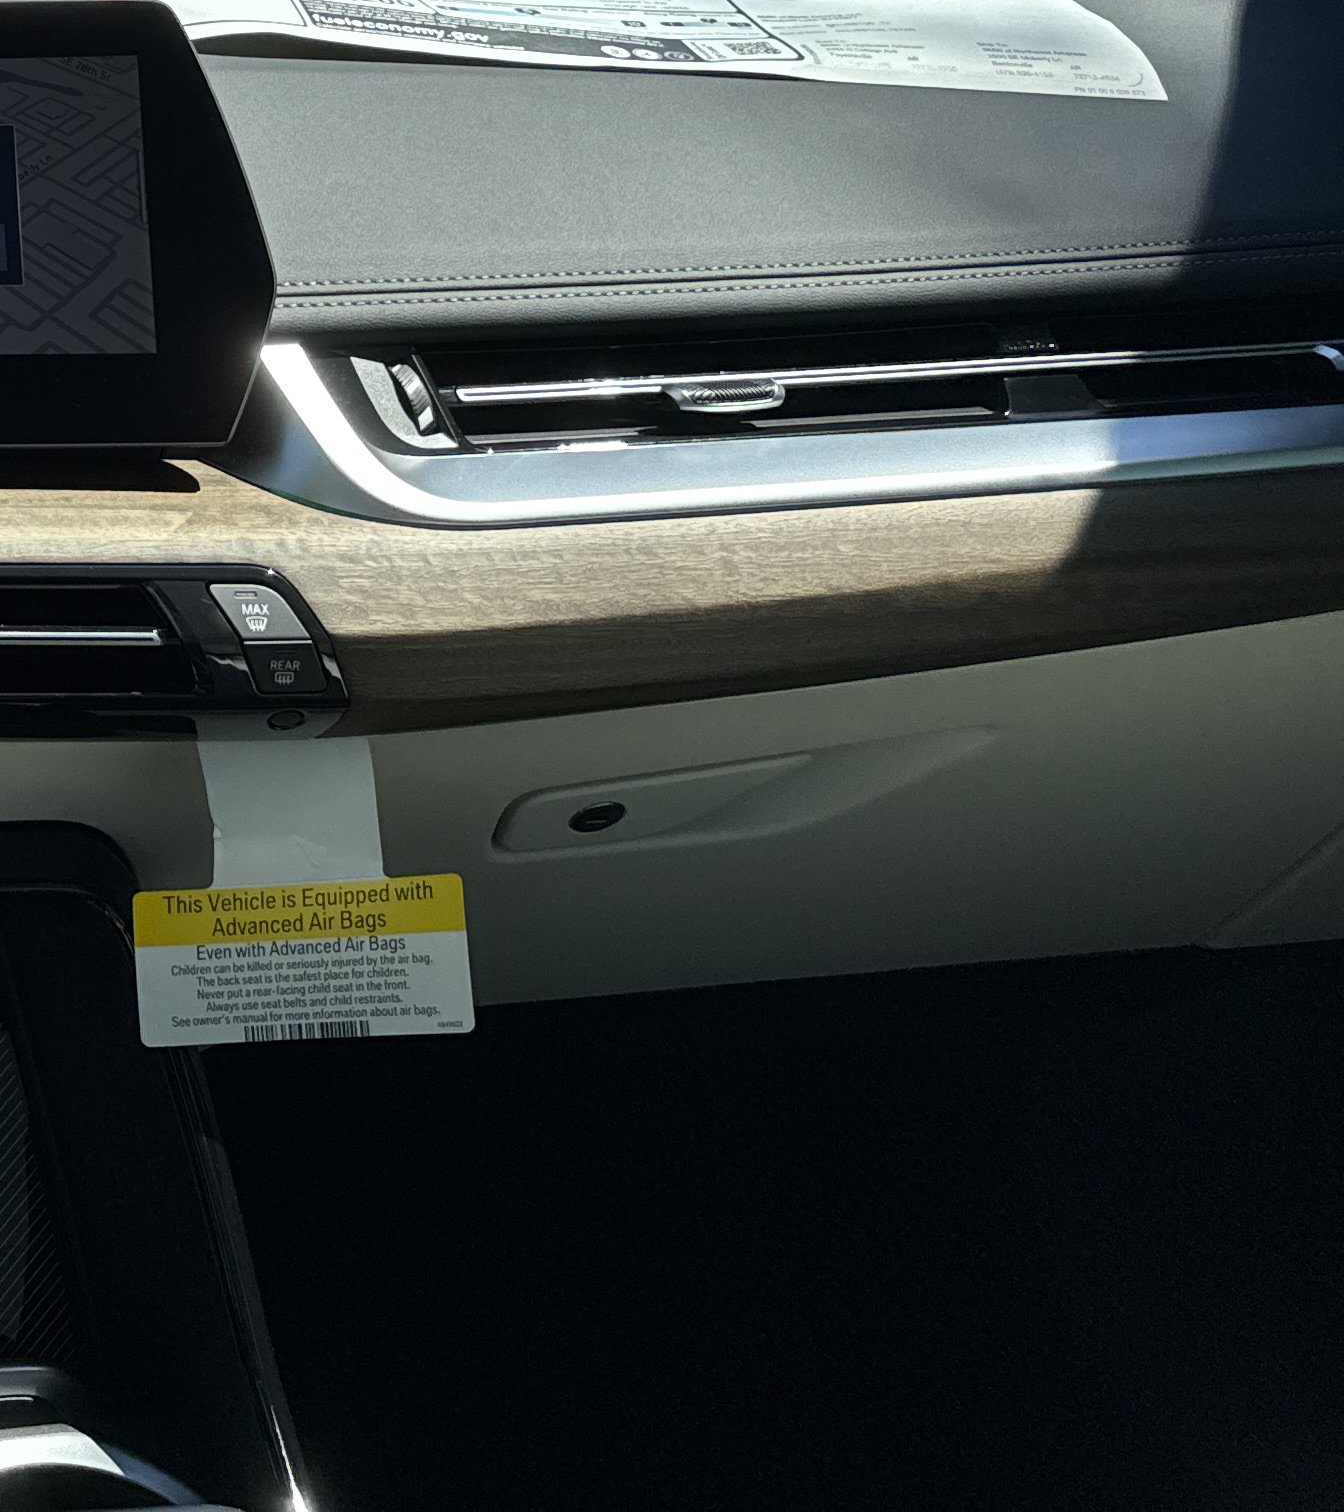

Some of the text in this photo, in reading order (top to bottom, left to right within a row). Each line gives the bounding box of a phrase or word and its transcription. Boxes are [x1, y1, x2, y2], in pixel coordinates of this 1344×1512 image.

[311, 13, 489, 43] fueleconomy.gov
[241, 603, 270, 616] MAX
[270, 660, 301, 671] REAR
[162, 881, 433, 914] This Vehicle is Equipped with
[212, 910, 387, 937] Advanced Air Bags
[196, 935, 406, 960] Even with Advanced Air Bags
[171, 953, 433, 976] Children can be killed or seriously injured by the air bag.
[196, 968, 409, 987] The back seat is the safest place for children.
[197, 979, 410, 1000] Never put a rear-facing child seat in the front.
[206, 993, 403, 1013] Always use seat belts and child restraints.
[172, 1004, 441, 1027] See owner's manual for more information about air bags.
